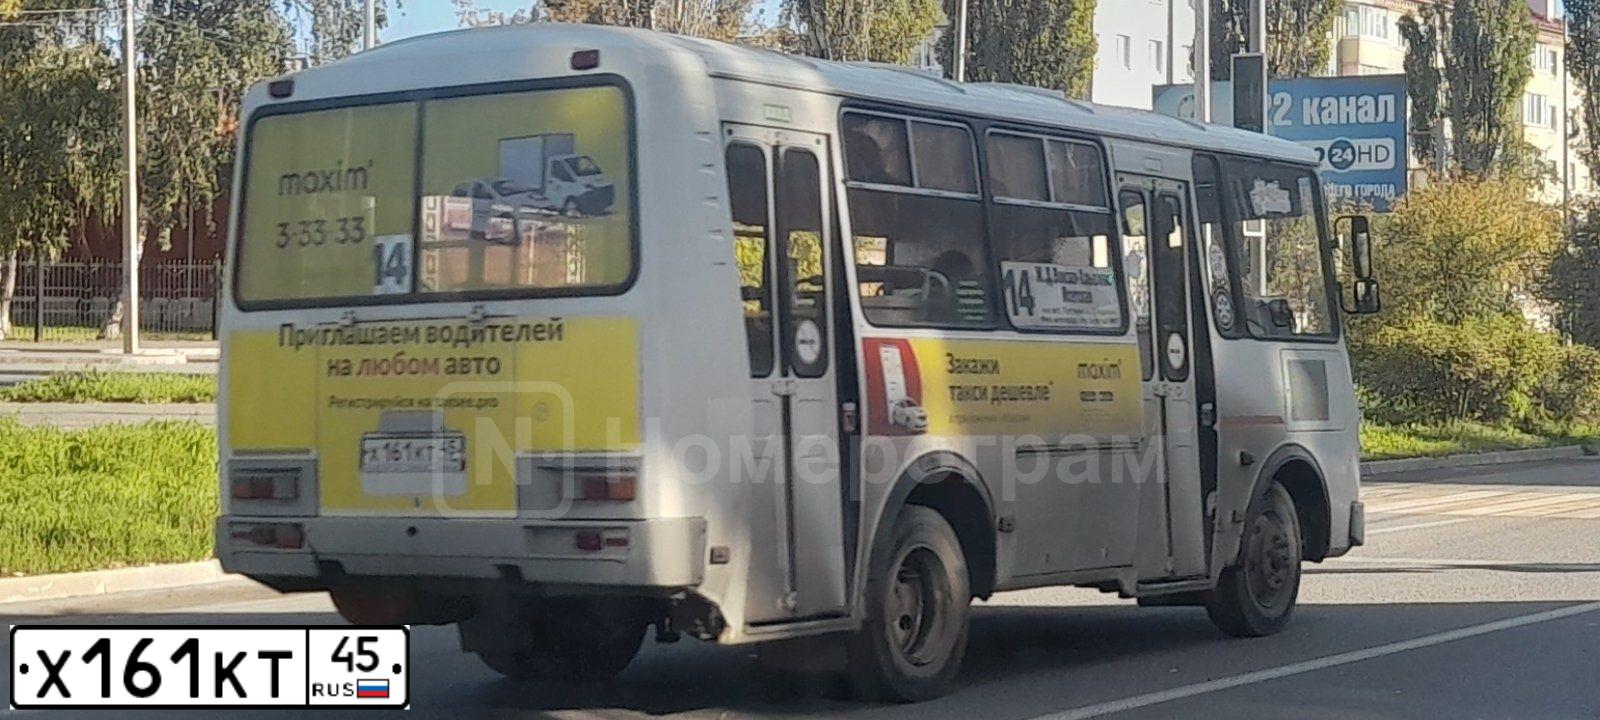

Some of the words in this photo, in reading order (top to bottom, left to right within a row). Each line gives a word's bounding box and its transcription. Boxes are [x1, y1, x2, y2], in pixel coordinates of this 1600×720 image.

[1302, 94, 1396, 126] канал
[1331, 148, 1354, 162] 24
[1357, 145, 1390, 163] HD
[276, 216, 367, 250] 3-33-33
[374, 239, 409, 287] 14
[1002, 269, 1036, 316] 14
[278, 321, 421, 350] Приглашаем
[425, 316, 564, 348] водителей
[327, 359, 352, 378] на
[357, 351, 440, 377] любом
[445, 355, 502, 376] авто
[945, 352, 1000, 375] Закажи
[948, 385, 988, 402] такси
